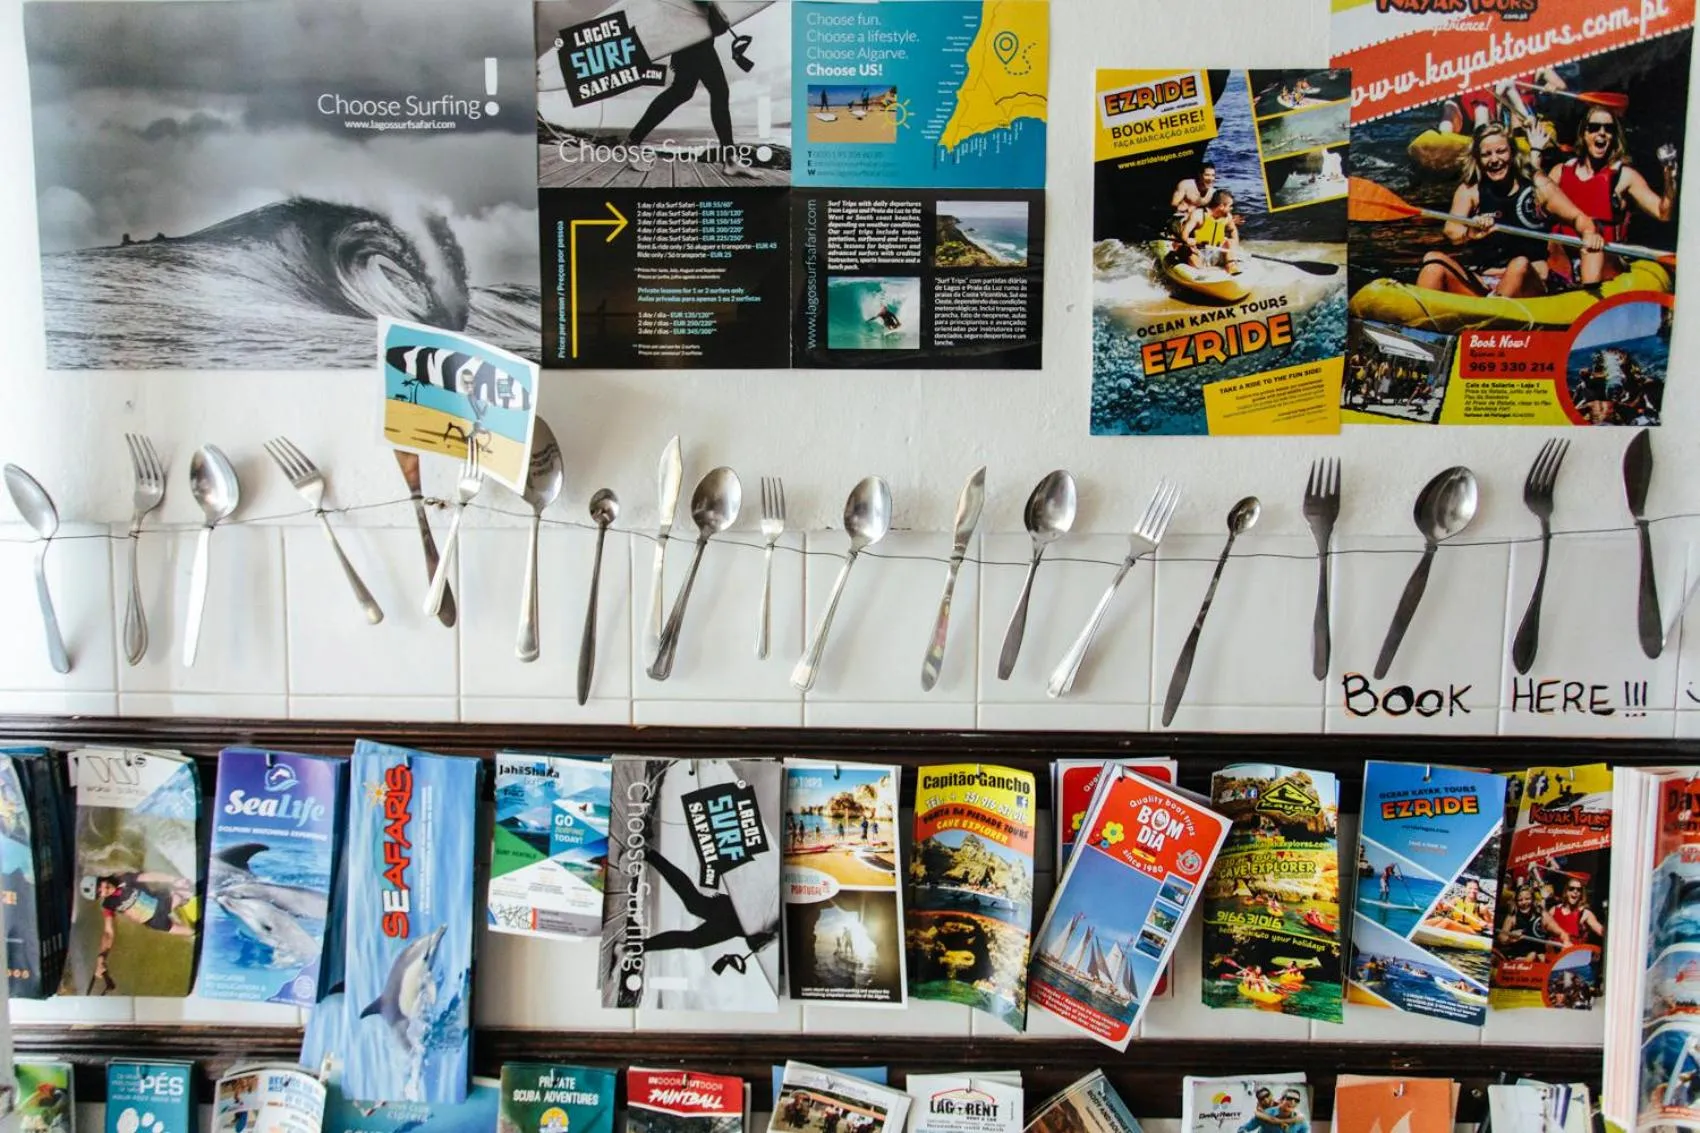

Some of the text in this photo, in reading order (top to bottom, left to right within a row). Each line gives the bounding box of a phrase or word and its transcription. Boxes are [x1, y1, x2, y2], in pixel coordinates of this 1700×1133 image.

[806, 12, 881, 26] Choose fun.
[574, 19, 621, 47] LAGOS
[806, 29, 920, 48] Choose a lifestyle.
[570, 37, 636, 79] SURF
[806, 46, 909, 62] Choose Algarve.
[806, 63, 883, 77] Choose US!
[317, 57, 500, 119] Choose Surfing!
[1104, 75, 1197, 117] EZRIDE
[344, 119, 456, 131] www.lagossurfsafari.com
[559, 96, 773, 168] Choose Surfing!
[1112, 110, 1205, 139] BOOK HERE!
[1113, 138, 1134, 149] FAÇA
[1136, 129, 1182, 146] MARCAÇÃO
[805, 199, 819, 350] www.lagossurfsafari.com
[1137, 296, 1288, 338] OCEAN KAYAK TOURS
[557, 337, 566, 358] Prices
[1140, 312, 1294, 377] EZRIDE
[1470, 335, 1531, 348] Book Now!
[1469, 362, 1555, 372] 969 330 214
[1220, 385, 1238, 394] TAKE
[1245, 381, 1261, 389] RIDE
[1274, 374, 1287, 383] THE
[1288, 371, 1303, 380] FUN
[1342, 672, 1473, 717] BOOK
[923, 771, 1030, 794] Capitão Gancho
[1379, 785, 1477, 799] OCEAN KAYAK TOURS
[224, 790, 325, 827] SeaLife
[1129, 795, 1196, 837] Quality boat trips
[1381, 794, 1480, 821] EZRIDE
[555, 814, 574, 827] GO
[627, 781, 651, 878] Choose
[707, 793, 746, 862] SURF
[737, 799, 762, 848] LAGOS
[1137, 805, 1185, 840] BOM
[382, 764, 413, 939] SEAFARIS
[1122, 849, 1141, 869] since
[1220, 860, 1317, 878] CAVE EXPLORER
[140, 1072, 184, 1096] PÉS
[513, 1089, 599, 1106] SCUBA ADVENTURES
[648, 1088, 724, 1109] PAINTBALL
